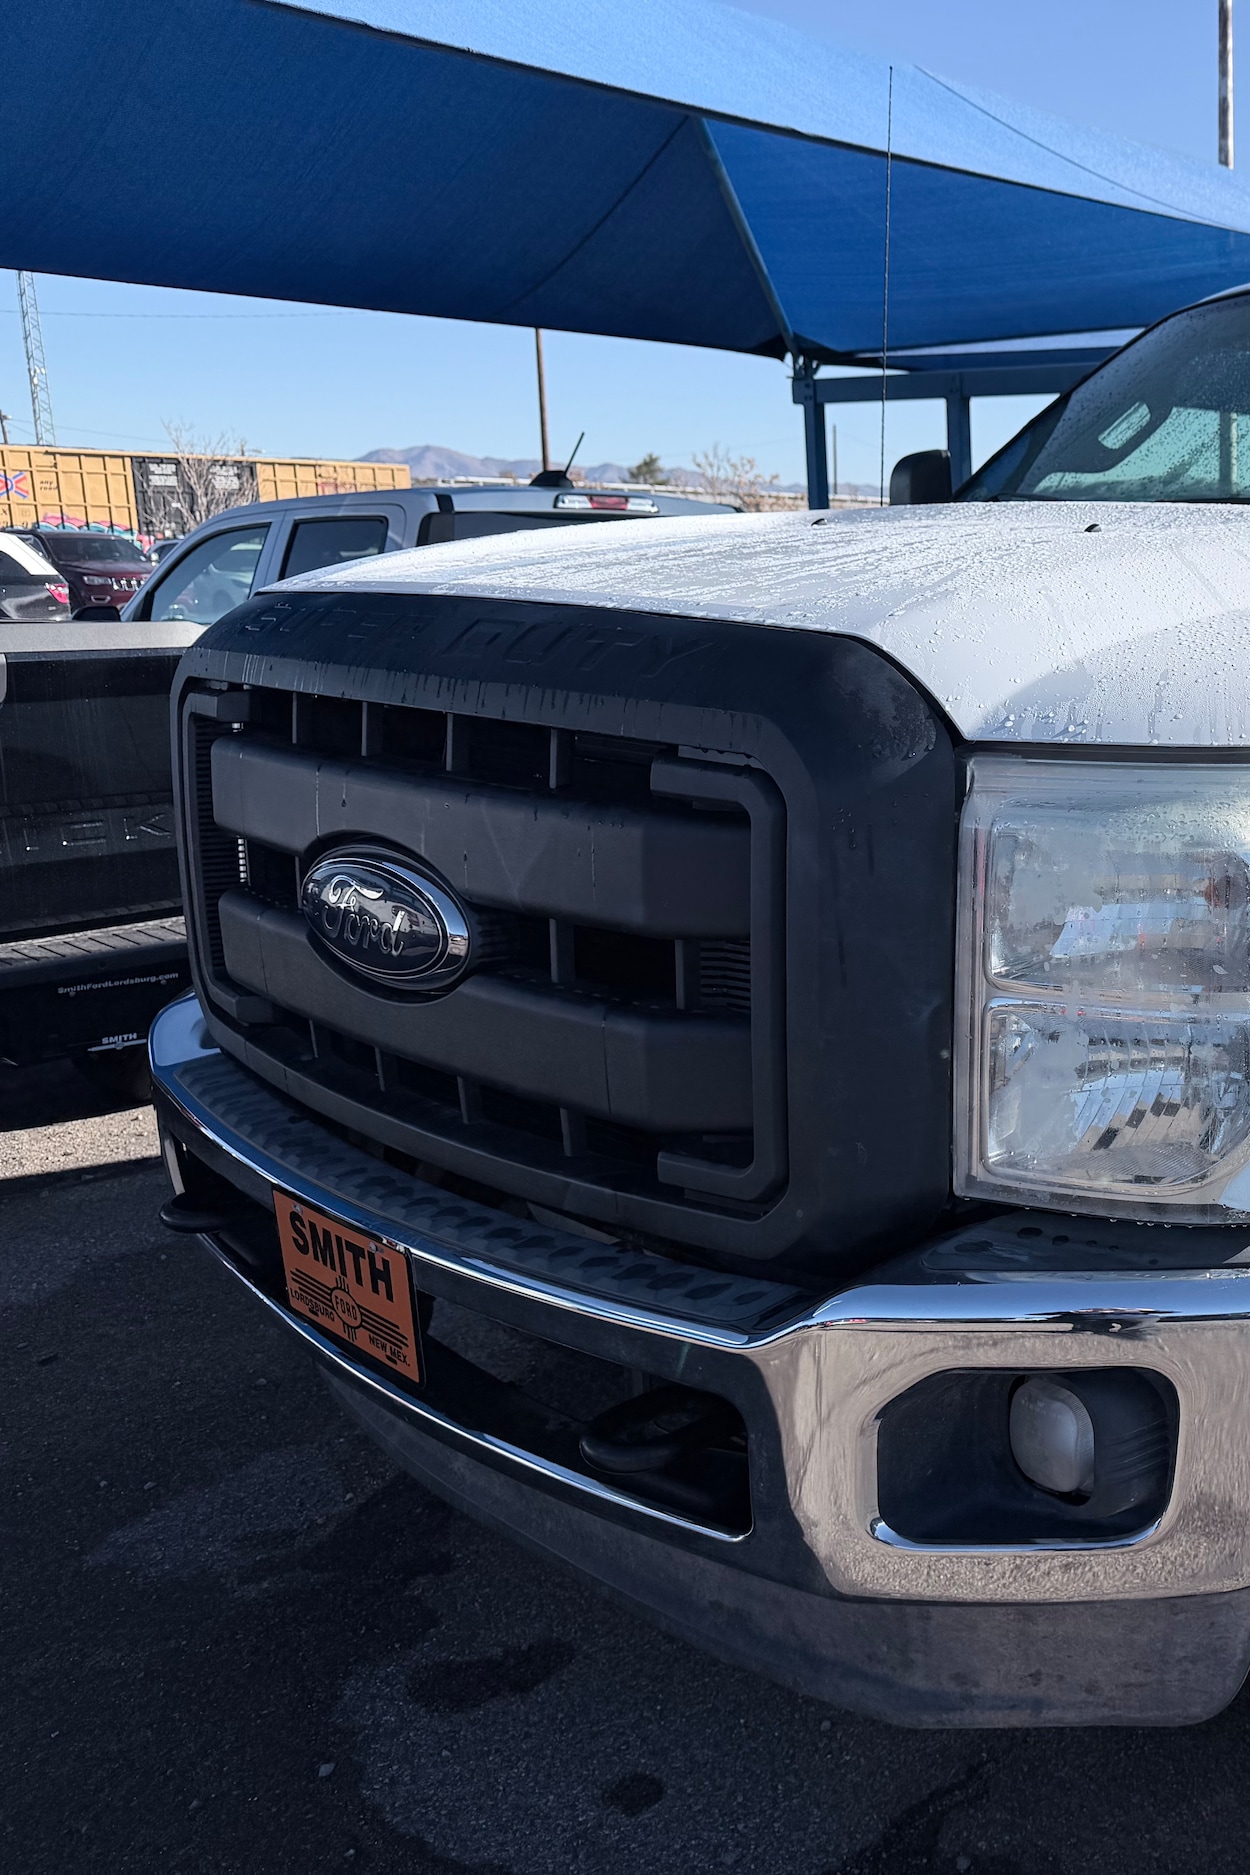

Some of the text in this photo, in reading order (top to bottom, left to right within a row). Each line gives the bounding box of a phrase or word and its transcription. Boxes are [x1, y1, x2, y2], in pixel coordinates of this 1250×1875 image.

[243, 602, 718, 679] SUPER DUTY
[322, 874, 404, 956] Ford
[58, 973, 178, 994] SmithFordLordsburg.com
[102, 1033, 137, 1044] SMITH
[289, 1211, 394, 1304] SMITH
[290, 1287, 335, 1323] LORDSBURG
[334, 1295, 358, 1321] FORD
[368, 1334, 411, 1367] NEW MEX.
